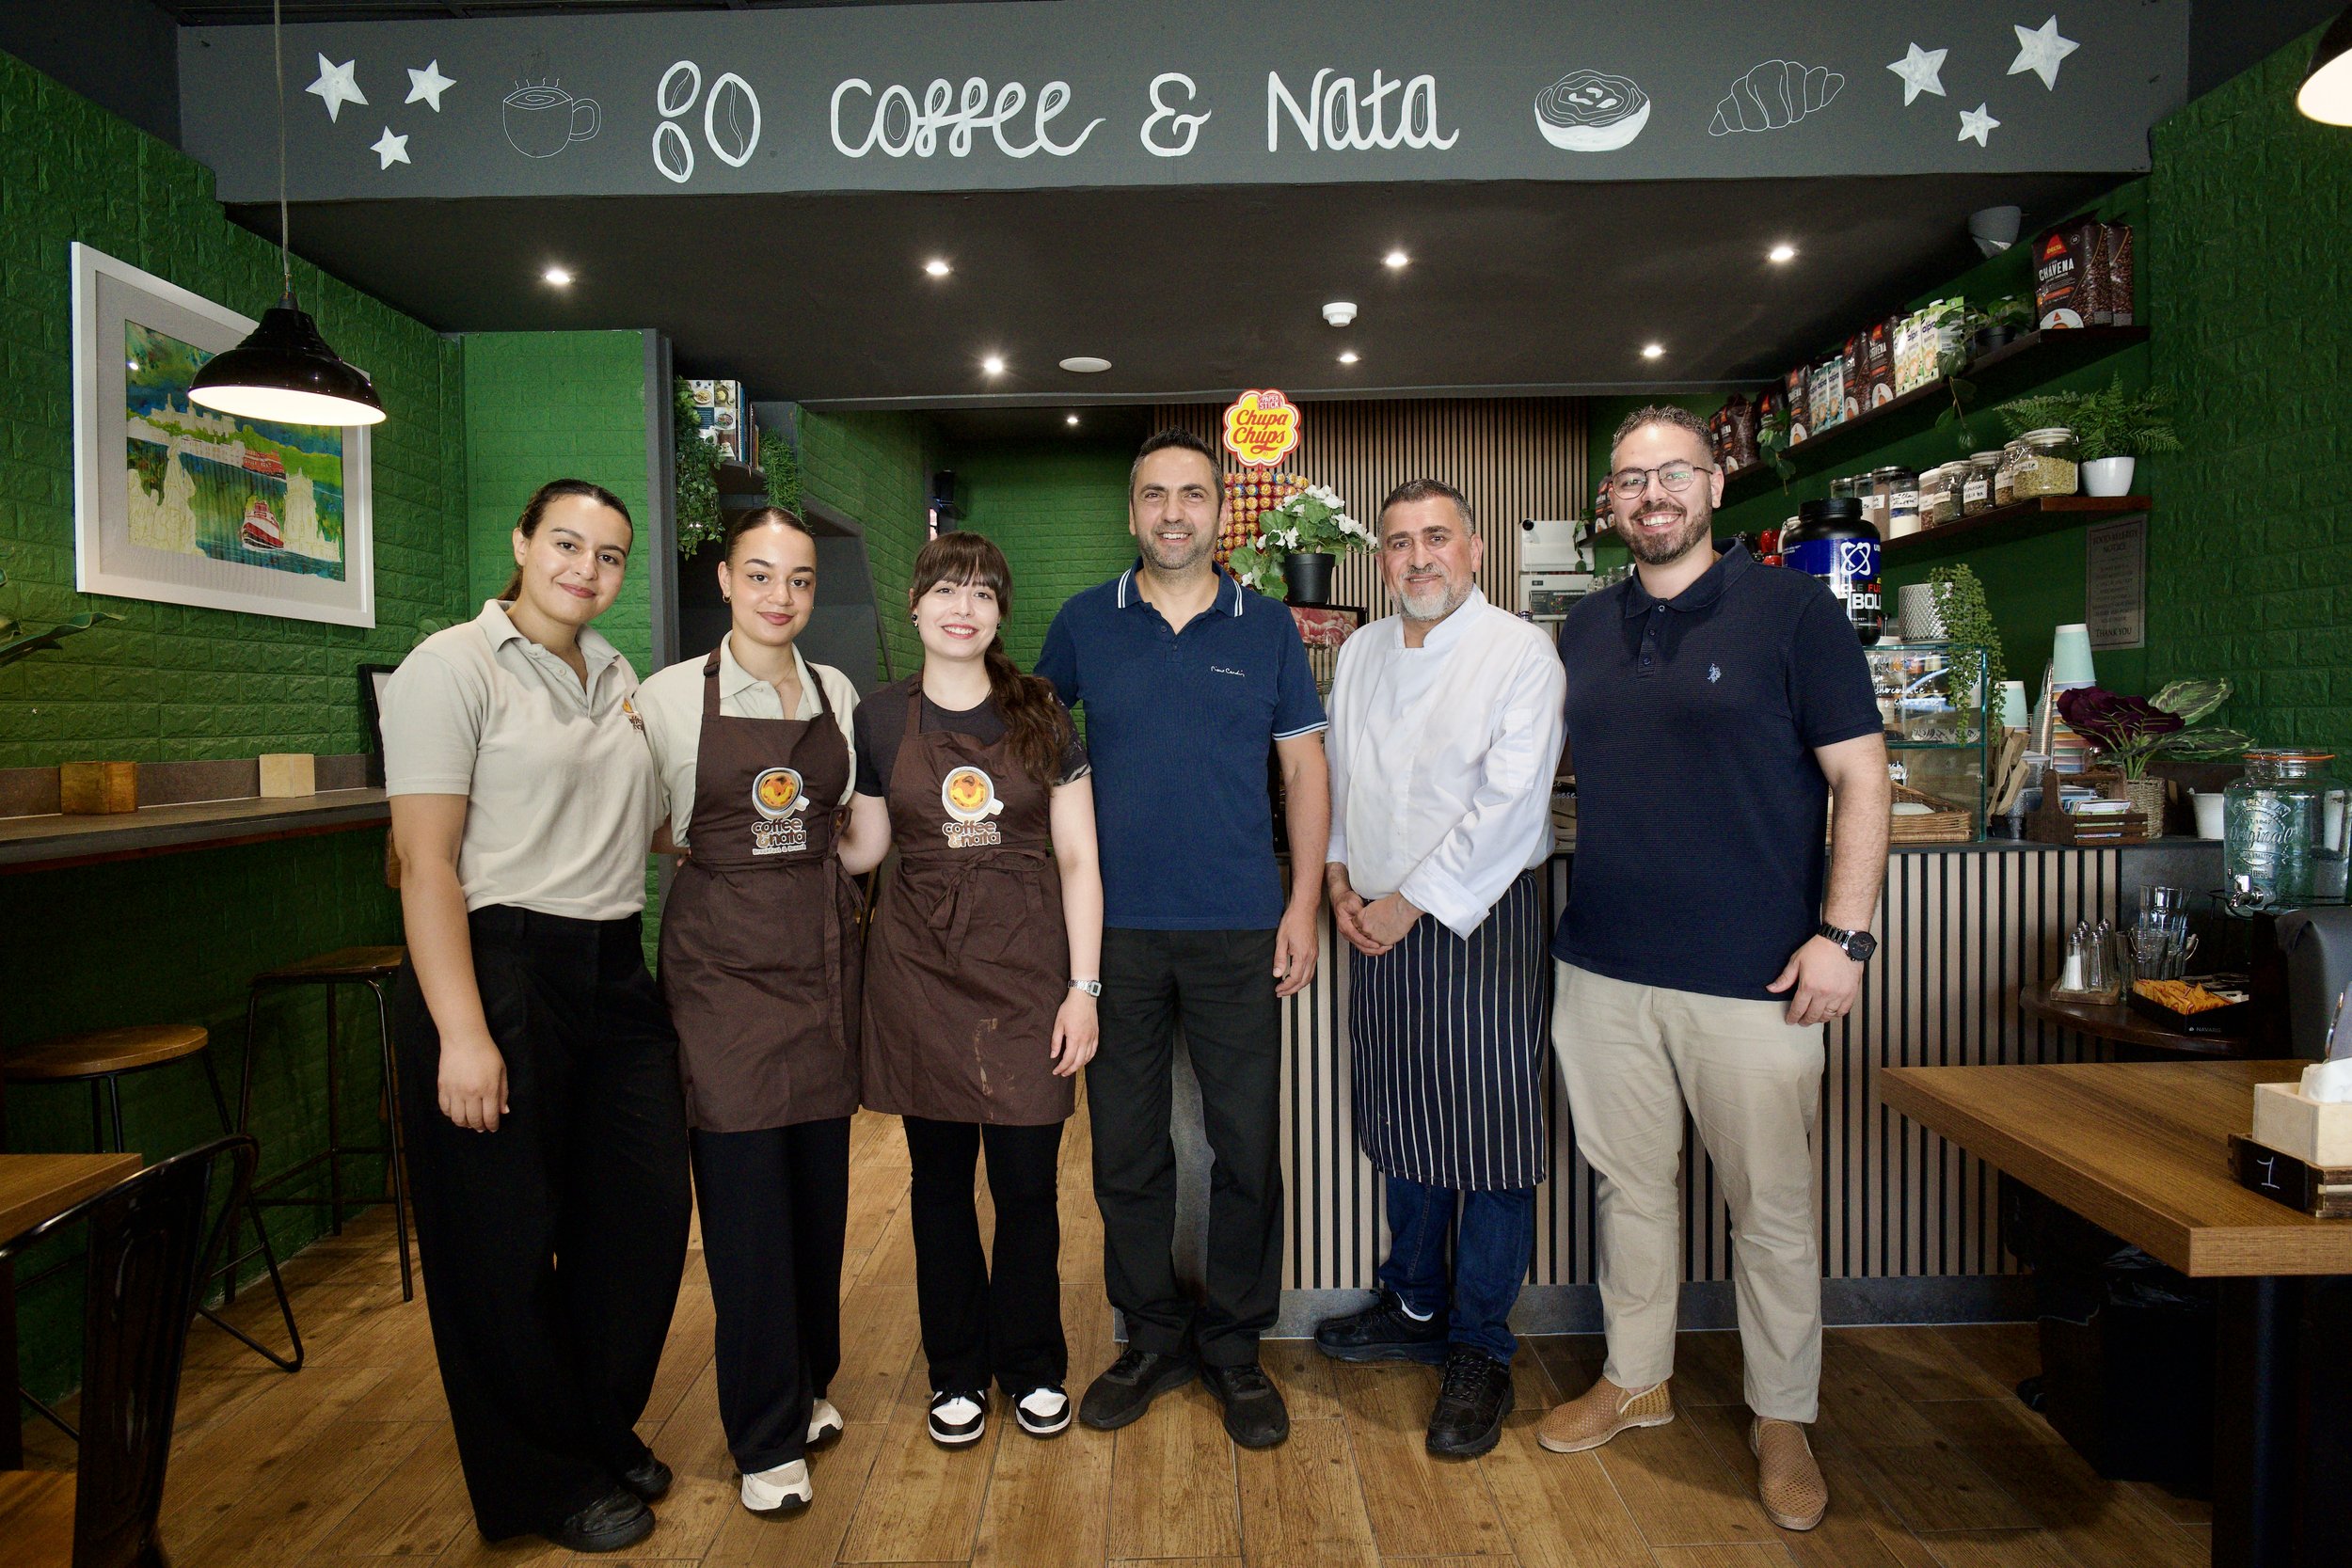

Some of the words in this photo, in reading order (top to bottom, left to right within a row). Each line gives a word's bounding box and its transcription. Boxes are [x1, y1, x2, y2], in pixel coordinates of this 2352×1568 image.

[830, 76, 1106, 159] Coffee
[1140, 72, 1212, 158] &
[1267, 67, 1459, 153] Nata
[1236, 409, 1289, 430] Chupa
[1232, 426, 1286, 454] Chups
[751, 817, 803, 835] coffee
[942, 820, 997, 836] coffee
[2256, 1156, 2280, 1190] 1
